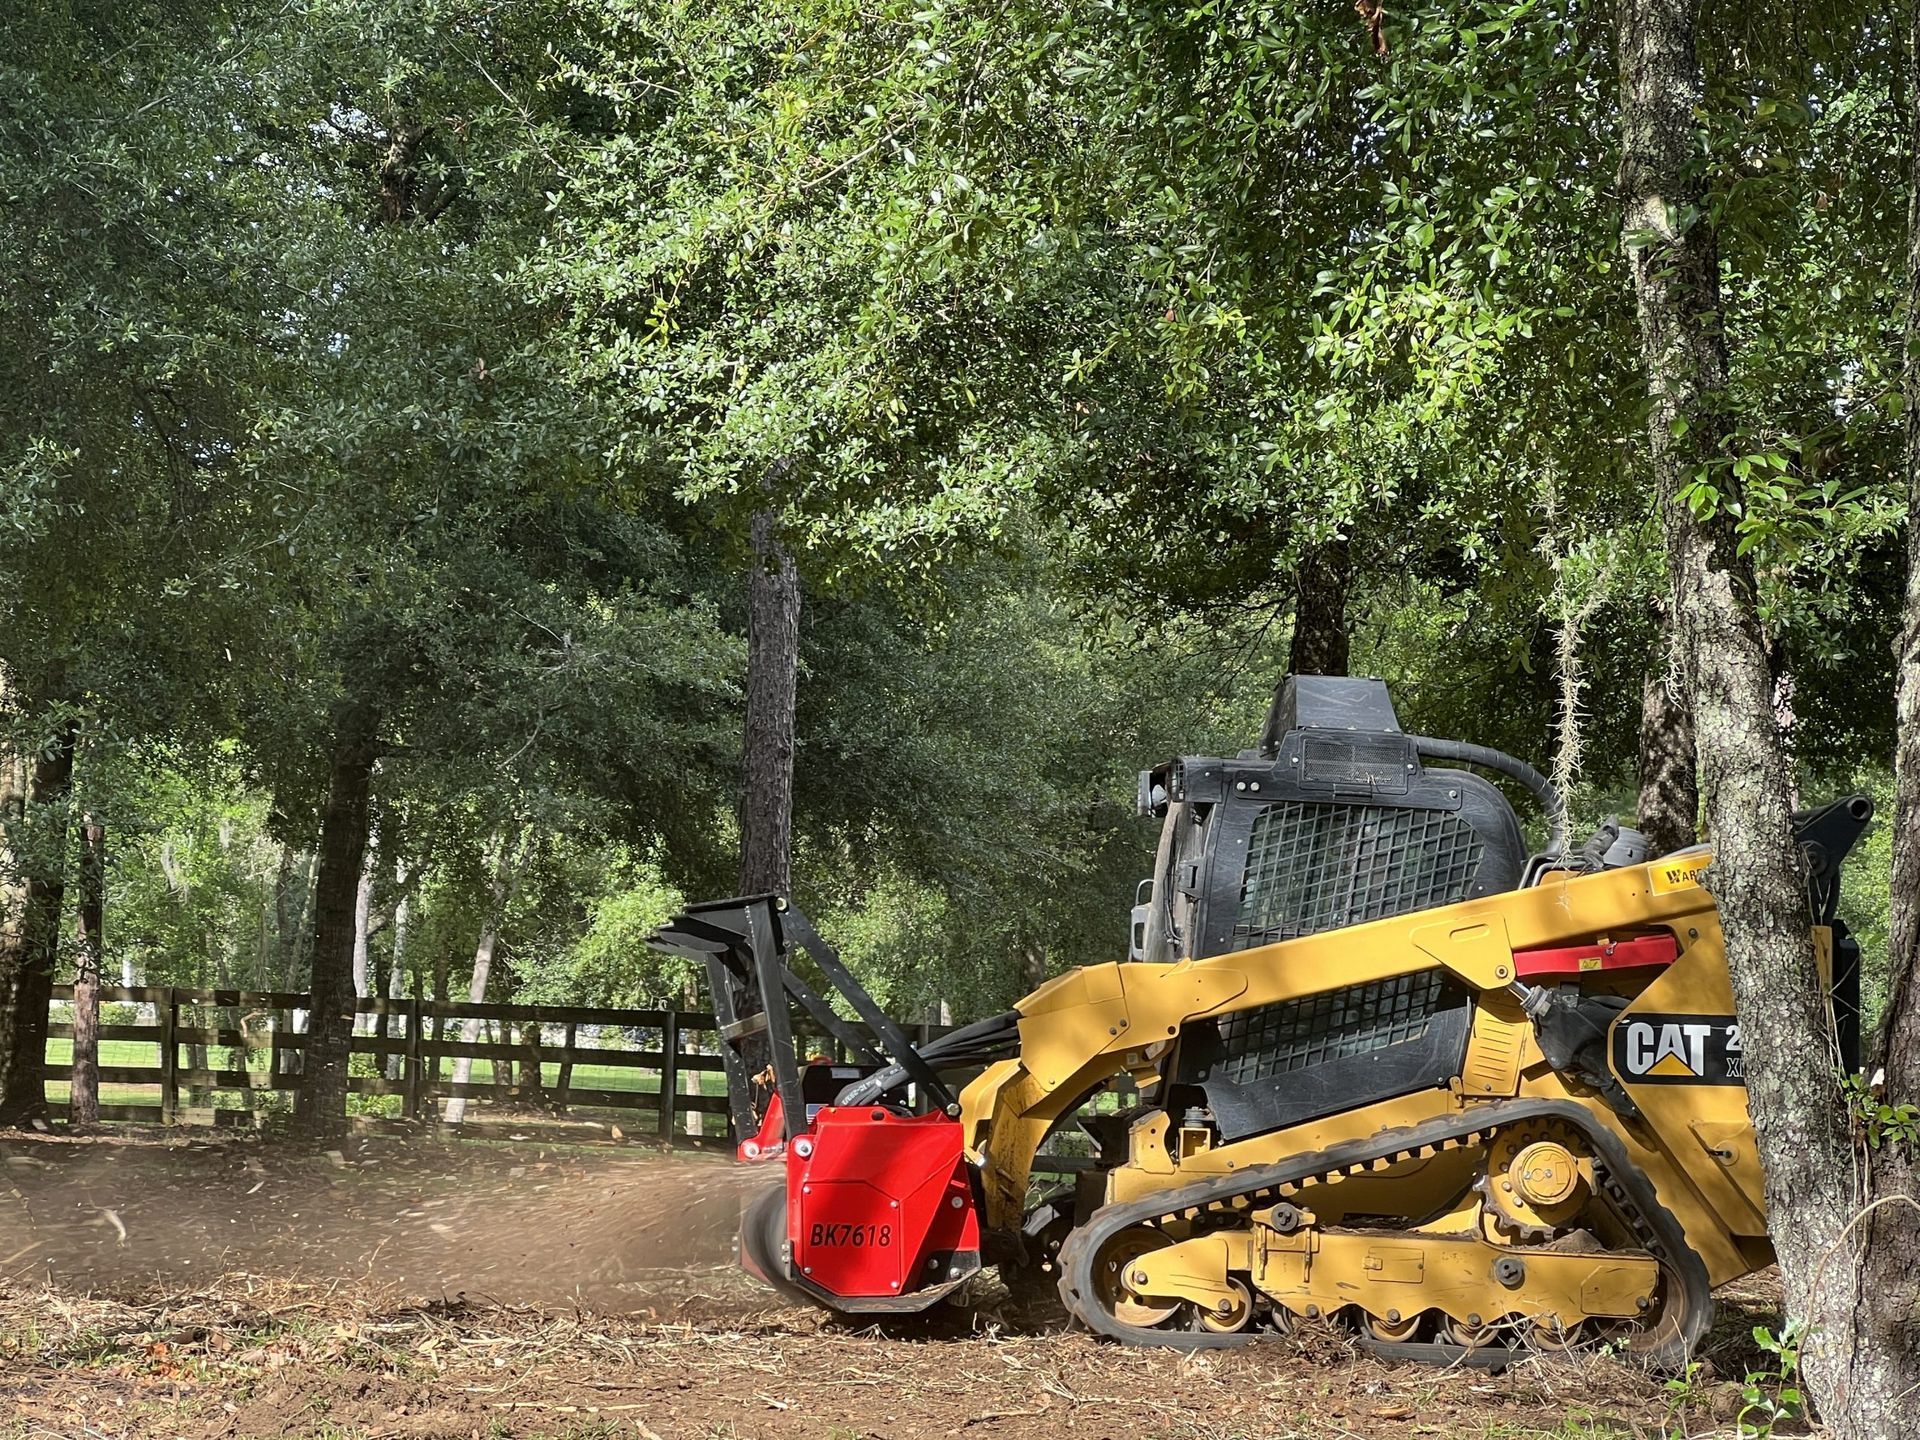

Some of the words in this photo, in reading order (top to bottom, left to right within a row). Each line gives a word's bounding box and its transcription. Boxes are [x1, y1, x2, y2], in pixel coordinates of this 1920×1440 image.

[1666, 868, 1701, 884] WAR
[1627, 1022, 1711, 1076] CAT
[810, 1223, 891, 1247] BK7618
